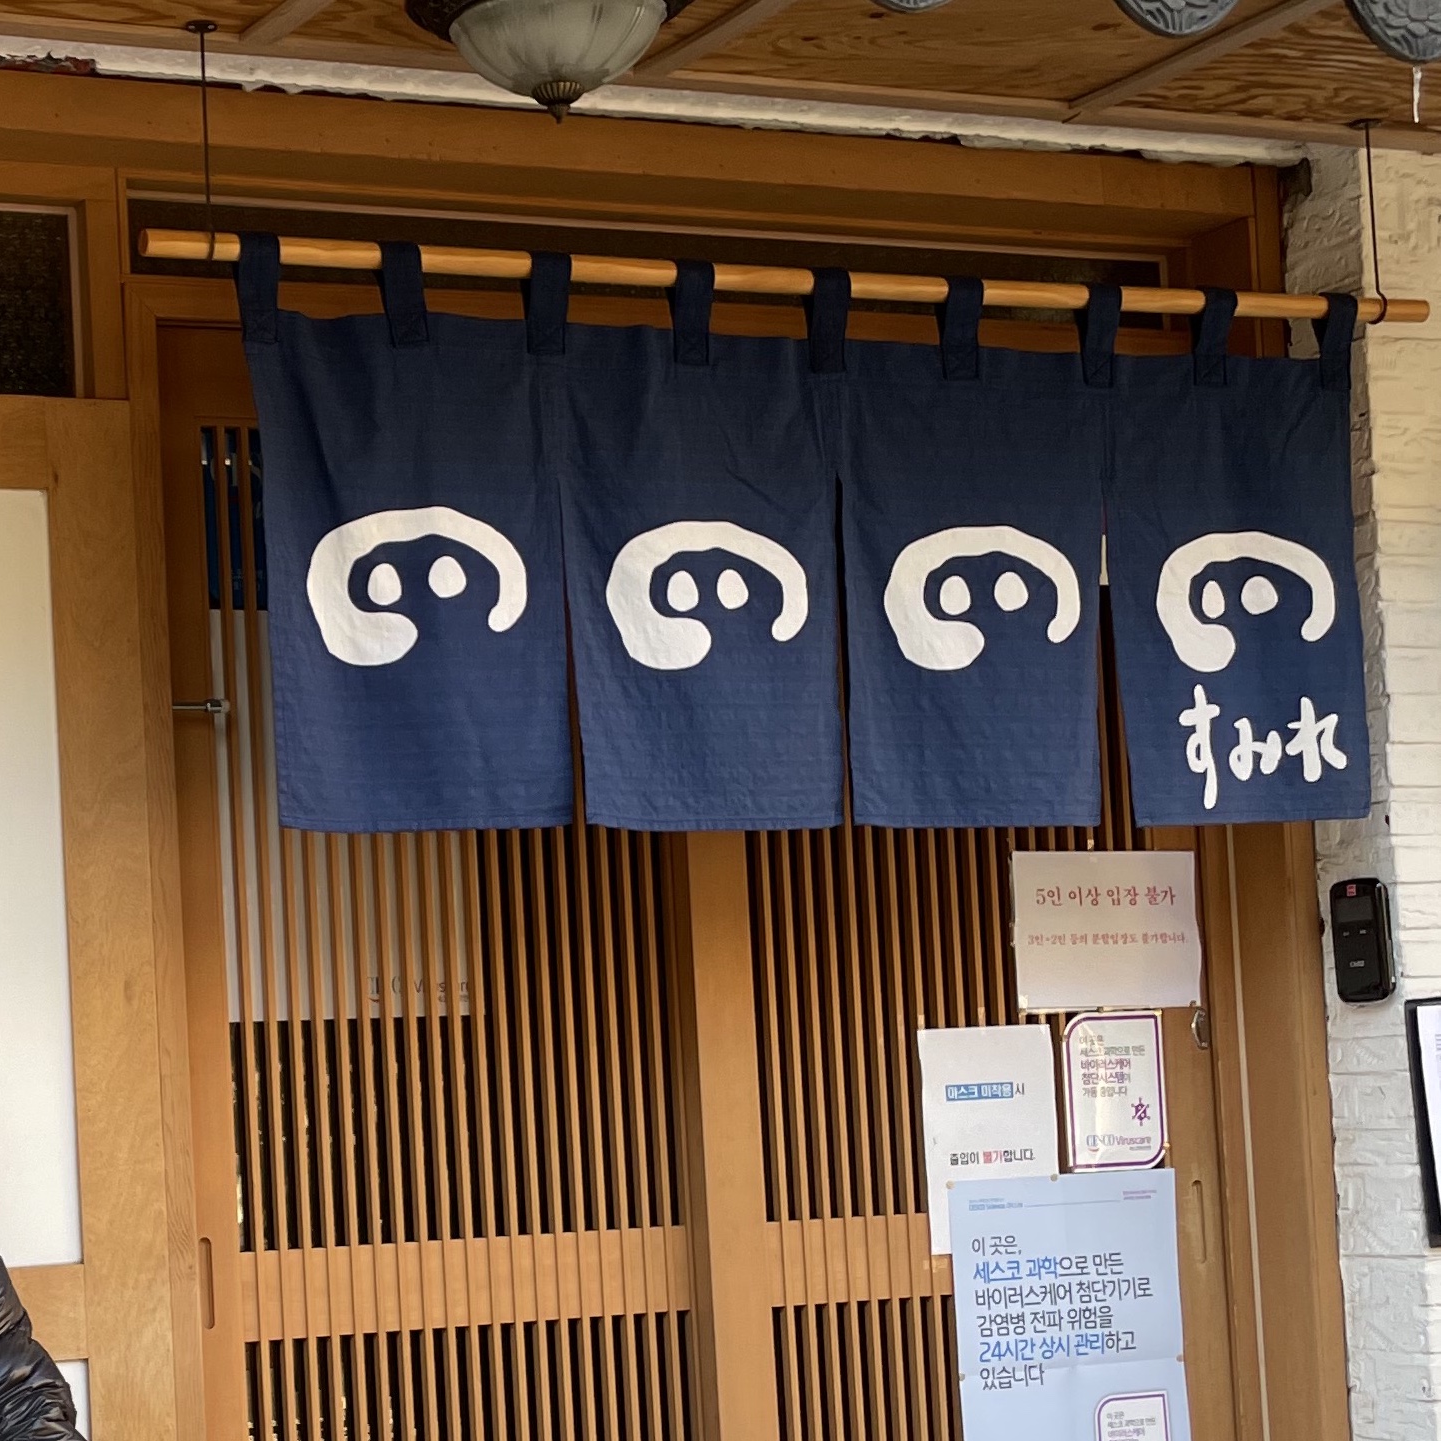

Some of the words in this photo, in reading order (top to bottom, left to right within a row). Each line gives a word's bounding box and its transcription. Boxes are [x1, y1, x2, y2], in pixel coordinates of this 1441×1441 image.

[1178, 683, 1348, 810] すみれ
[1036, 886, 1063, 907] 5인
[1068, 885, 1101, 907] 이상
[1106, 885, 1140, 906] 입장
[1144, 885, 1177, 906] 불가
[947, 1085, 979, 1099] 마스크
[1015, 1082, 1025, 1095] 시
[971, 1237, 986, 1256] 이
[989, 1235, 1022, 1256] 곳은,
[973, 1259, 1023, 1284] 세스코
[1025, 1256, 1091, 1280] 과학으로
[1093, 1252, 1124, 1276] 만든
[975, 1282, 1074, 1311] 바이러스케어
[1076, 1277, 1154, 1304] 첨단기기로
[976, 1311, 1026, 1338] 감염병
[1029, 1309, 1064, 1334] 전파
[1066, 1305, 1114, 1330] 위험을
[979, 1338, 1036, 1363] 24시간
[1039, 1334, 1070, 1360] 상시
[1074, 1330, 1137, 1356] 관리하고
[979, 1363, 1045, 1391] 있습니다
